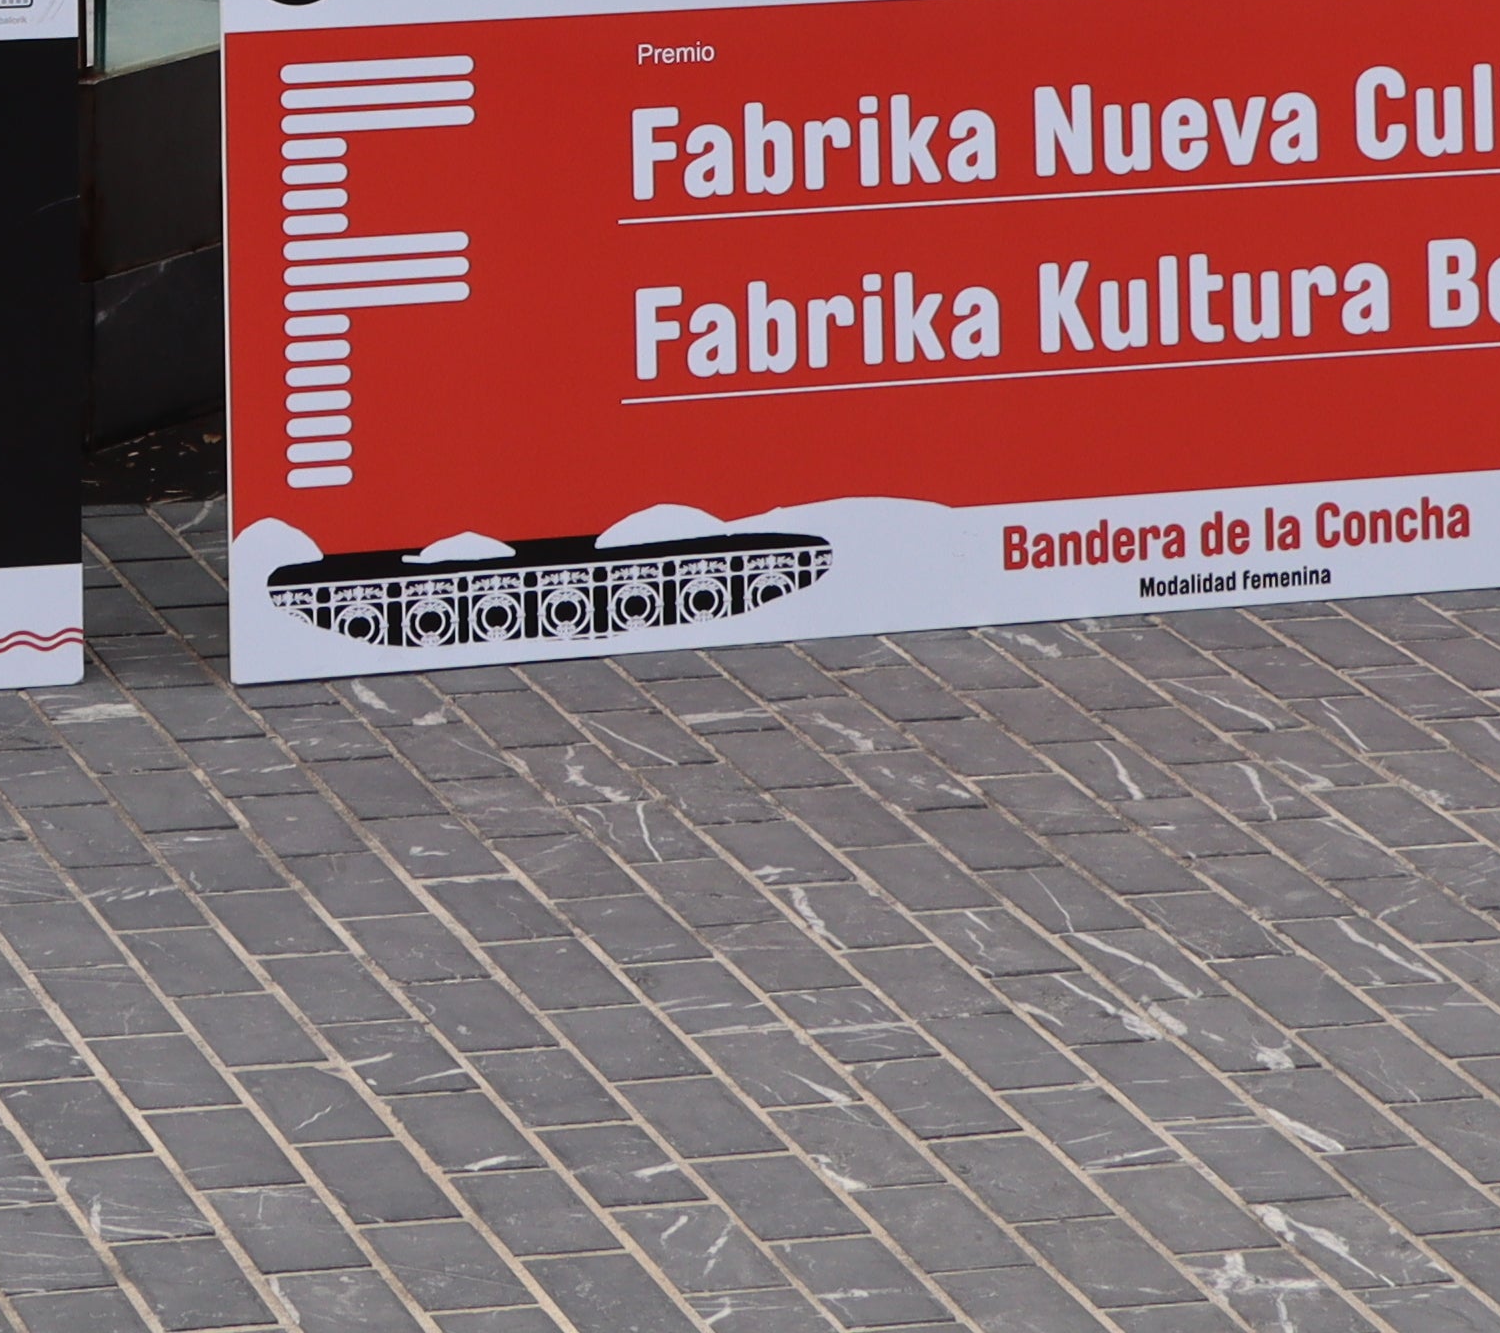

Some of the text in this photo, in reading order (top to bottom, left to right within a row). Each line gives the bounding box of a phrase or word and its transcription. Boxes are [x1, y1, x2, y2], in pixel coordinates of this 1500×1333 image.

[638, 42, 715, 65] Premio
[632, 94, 997, 201] Fabrika
[1034, 84, 1318, 177] Nueva
[635, 270, 1001, 381] Fabrika
[1039, 253, 1390, 354] Kultura
[1003, 496, 1471, 571] Bandera de la Concha
[1139, 564, 1332, 599] Modalidad femenina
